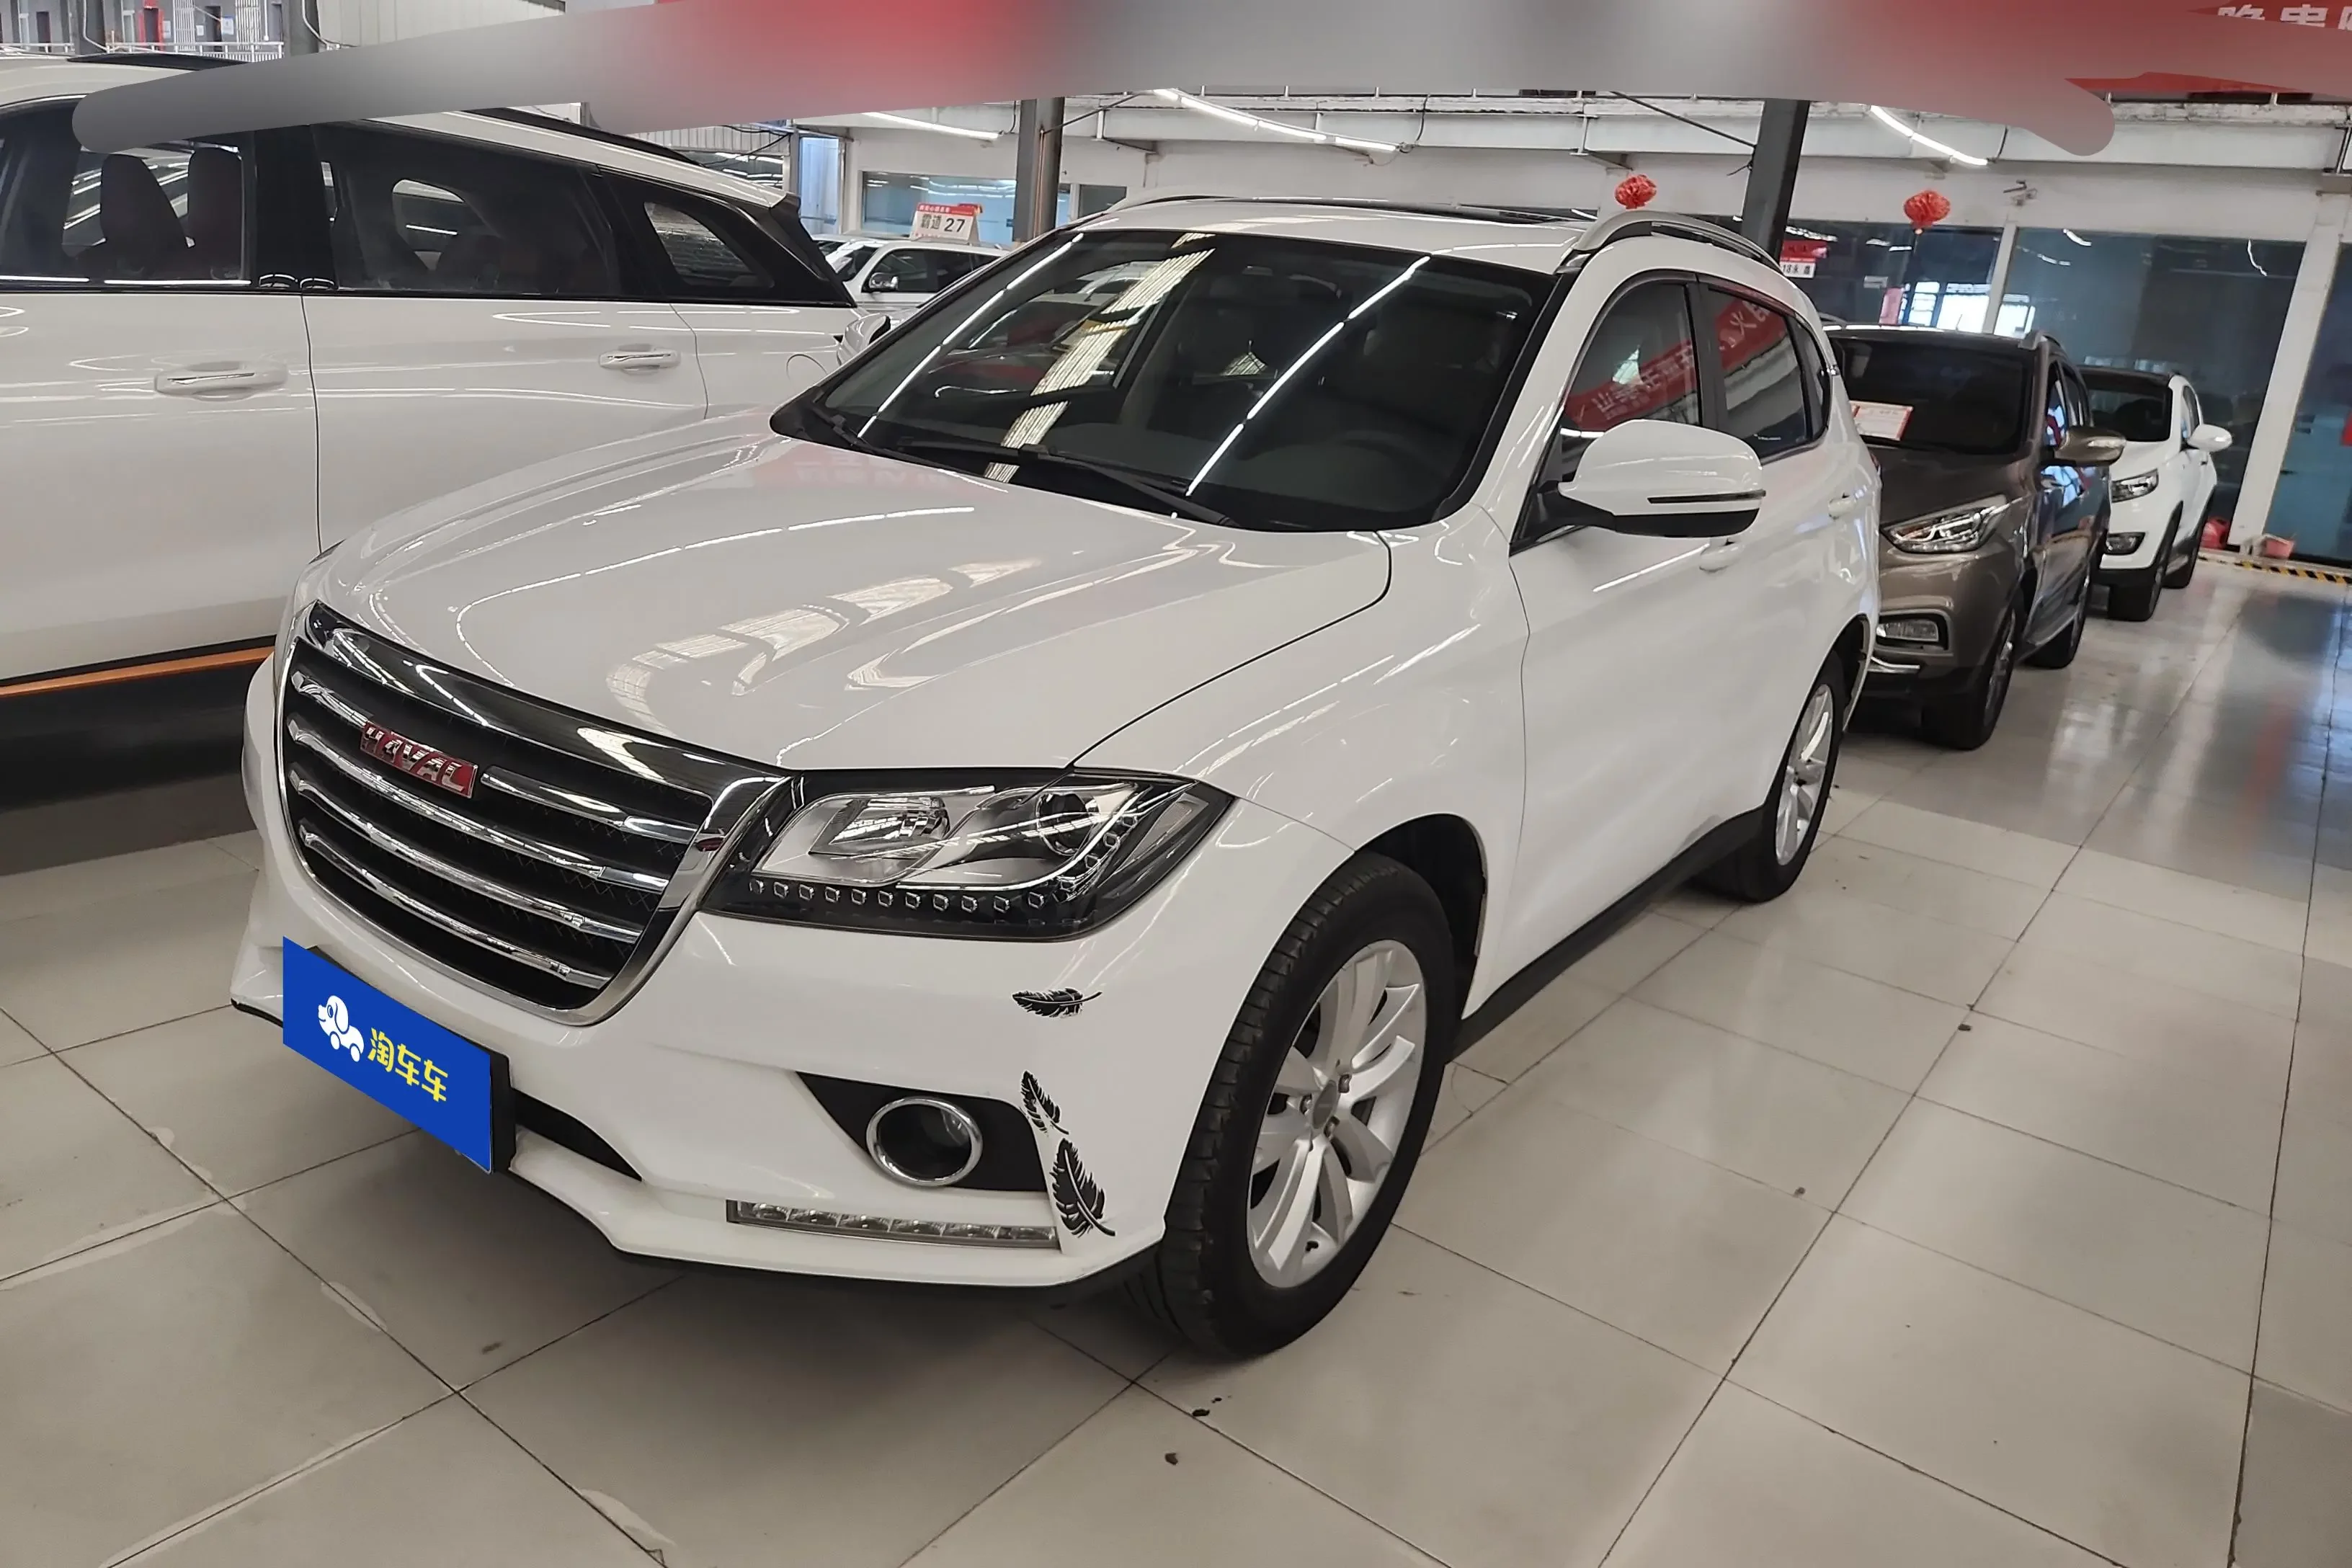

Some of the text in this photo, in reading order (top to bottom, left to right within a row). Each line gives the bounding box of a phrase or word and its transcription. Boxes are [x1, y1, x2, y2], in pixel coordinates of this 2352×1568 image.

[921, 213, 966, 232] 霸道 27
[362, 726, 466, 792] HAVAL
